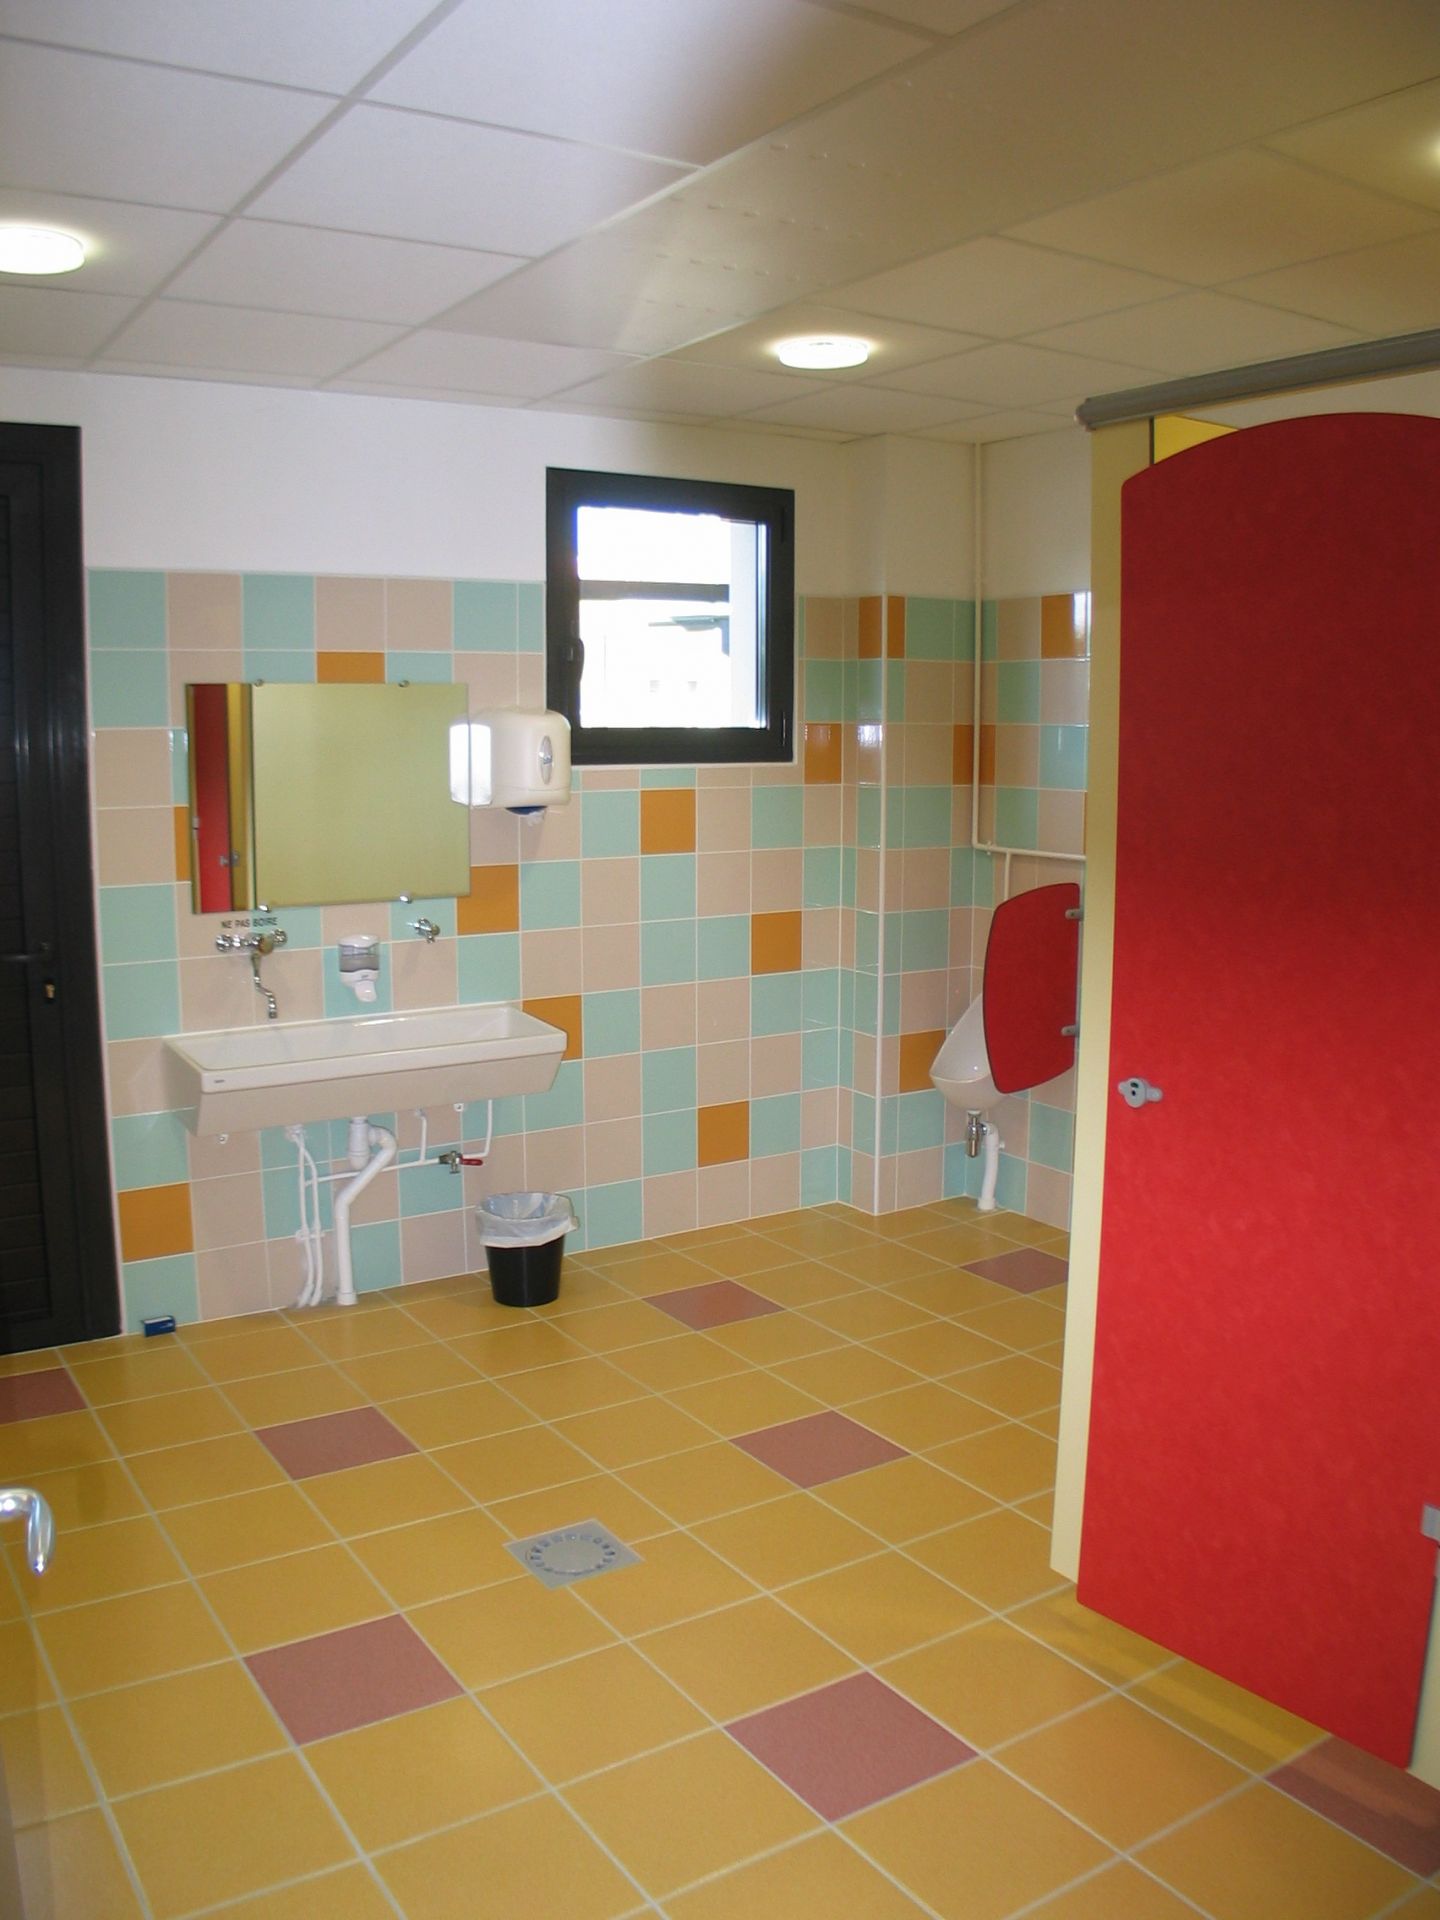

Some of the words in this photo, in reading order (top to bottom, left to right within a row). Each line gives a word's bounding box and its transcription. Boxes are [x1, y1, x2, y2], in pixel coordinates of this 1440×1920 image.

[221, 919, 233, 929] NE
[235, 918, 250, 928] PAS
[252, 917, 278, 928] BOIRE
